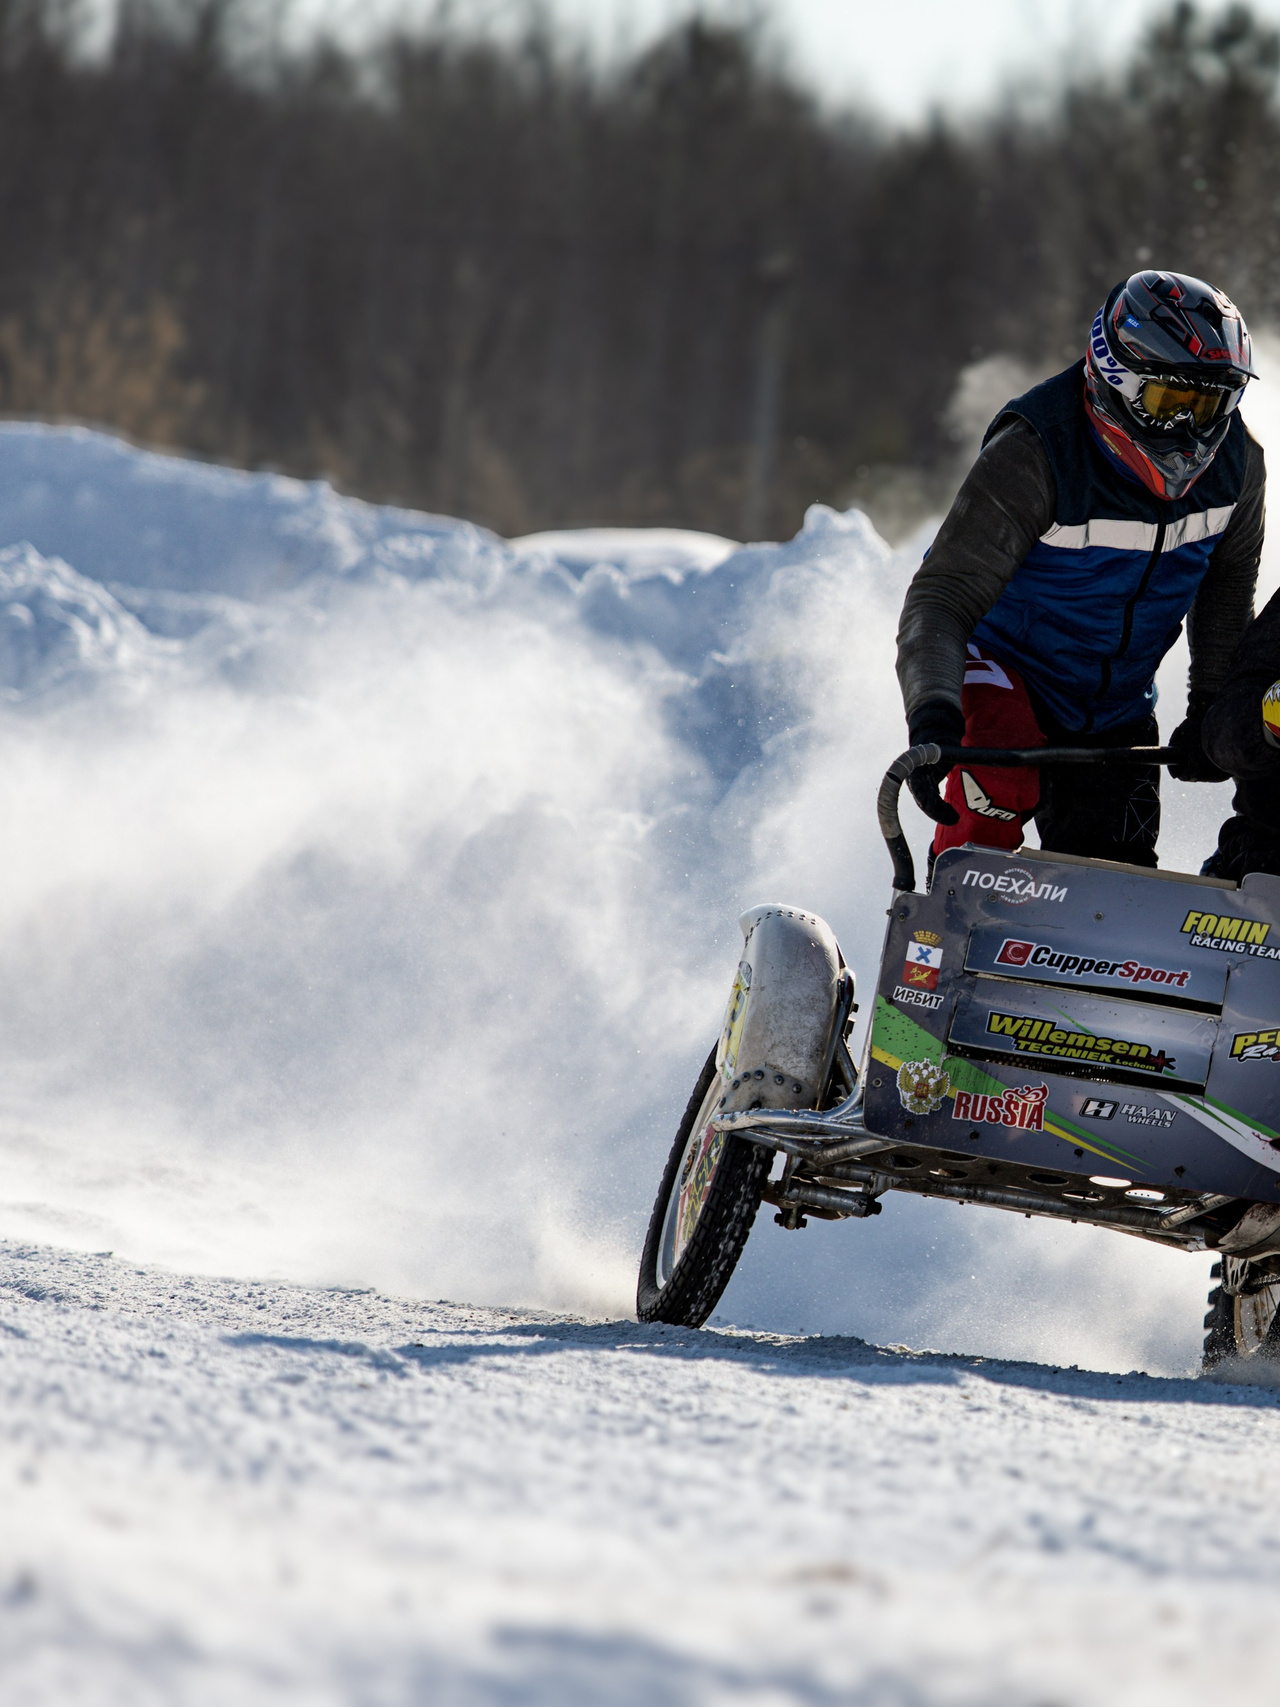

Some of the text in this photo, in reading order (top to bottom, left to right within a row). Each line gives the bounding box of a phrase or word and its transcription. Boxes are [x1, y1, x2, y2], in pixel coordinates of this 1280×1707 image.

[977, 806, 1017, 821] UFO
[961, 869, 1068, 903] ПОЕХАЛИ
[1181, 910, 1271, 945] FOMIN
[1190, 934, 1246, 953] RACING
[1030, 946, 1190, 987] CupperSport
[894, 986, 943, 1009] ИРБИТ
[988, 1014, 1151, 1059] Willemsen
[1016, 1040, 1156, 1071] TECHNIEK Lochem
[953, 1089, 1046, 1131] RUSSIA
[1120, 1104, 1179, 1121] HAAN
[1127, 1115, 1172, 1128] WHEELS
